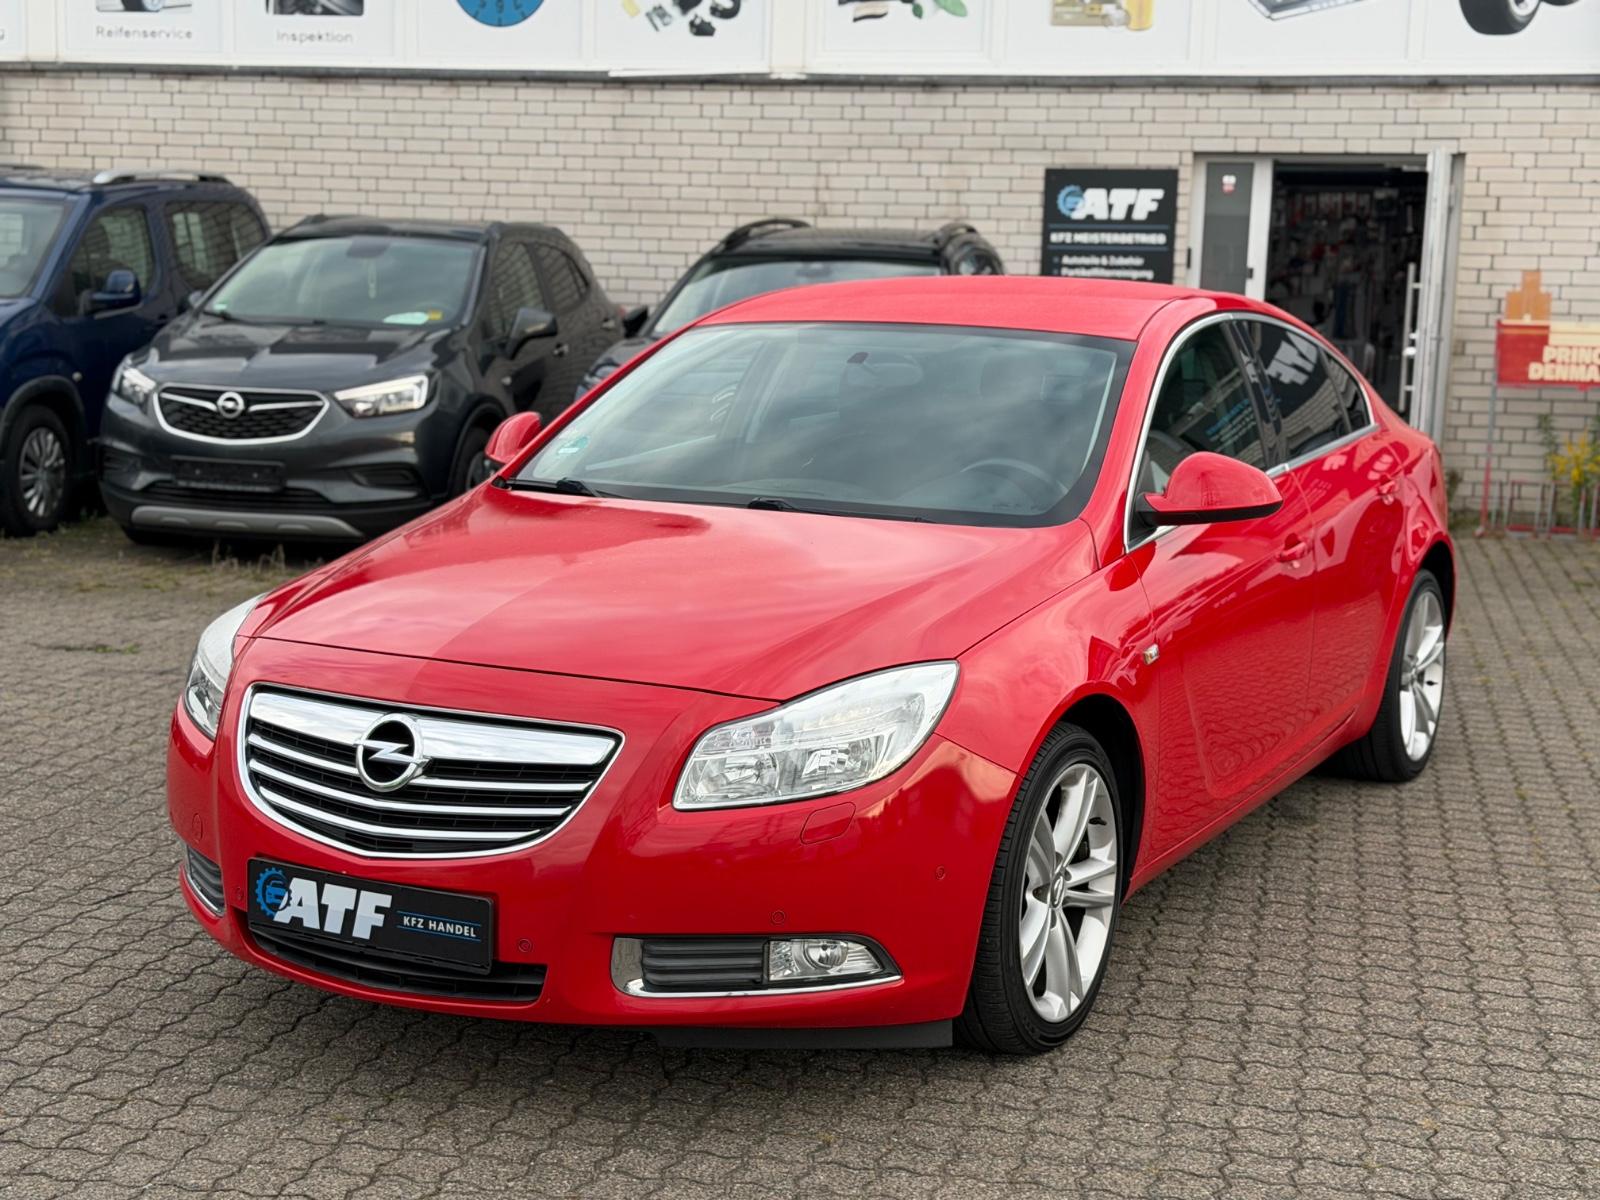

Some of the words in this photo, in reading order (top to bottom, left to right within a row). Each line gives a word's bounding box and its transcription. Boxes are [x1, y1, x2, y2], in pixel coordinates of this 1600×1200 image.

[96, 25, 193, 39] Reifenservice
[276, 28, 354, 43] Inspektion
[1070, 188, 1165, 220] ATF
[273, 877, 393, 940] ATF
[403, 915, 425, 930] KFZ
[428, 920, 477, 938] HANDEL
